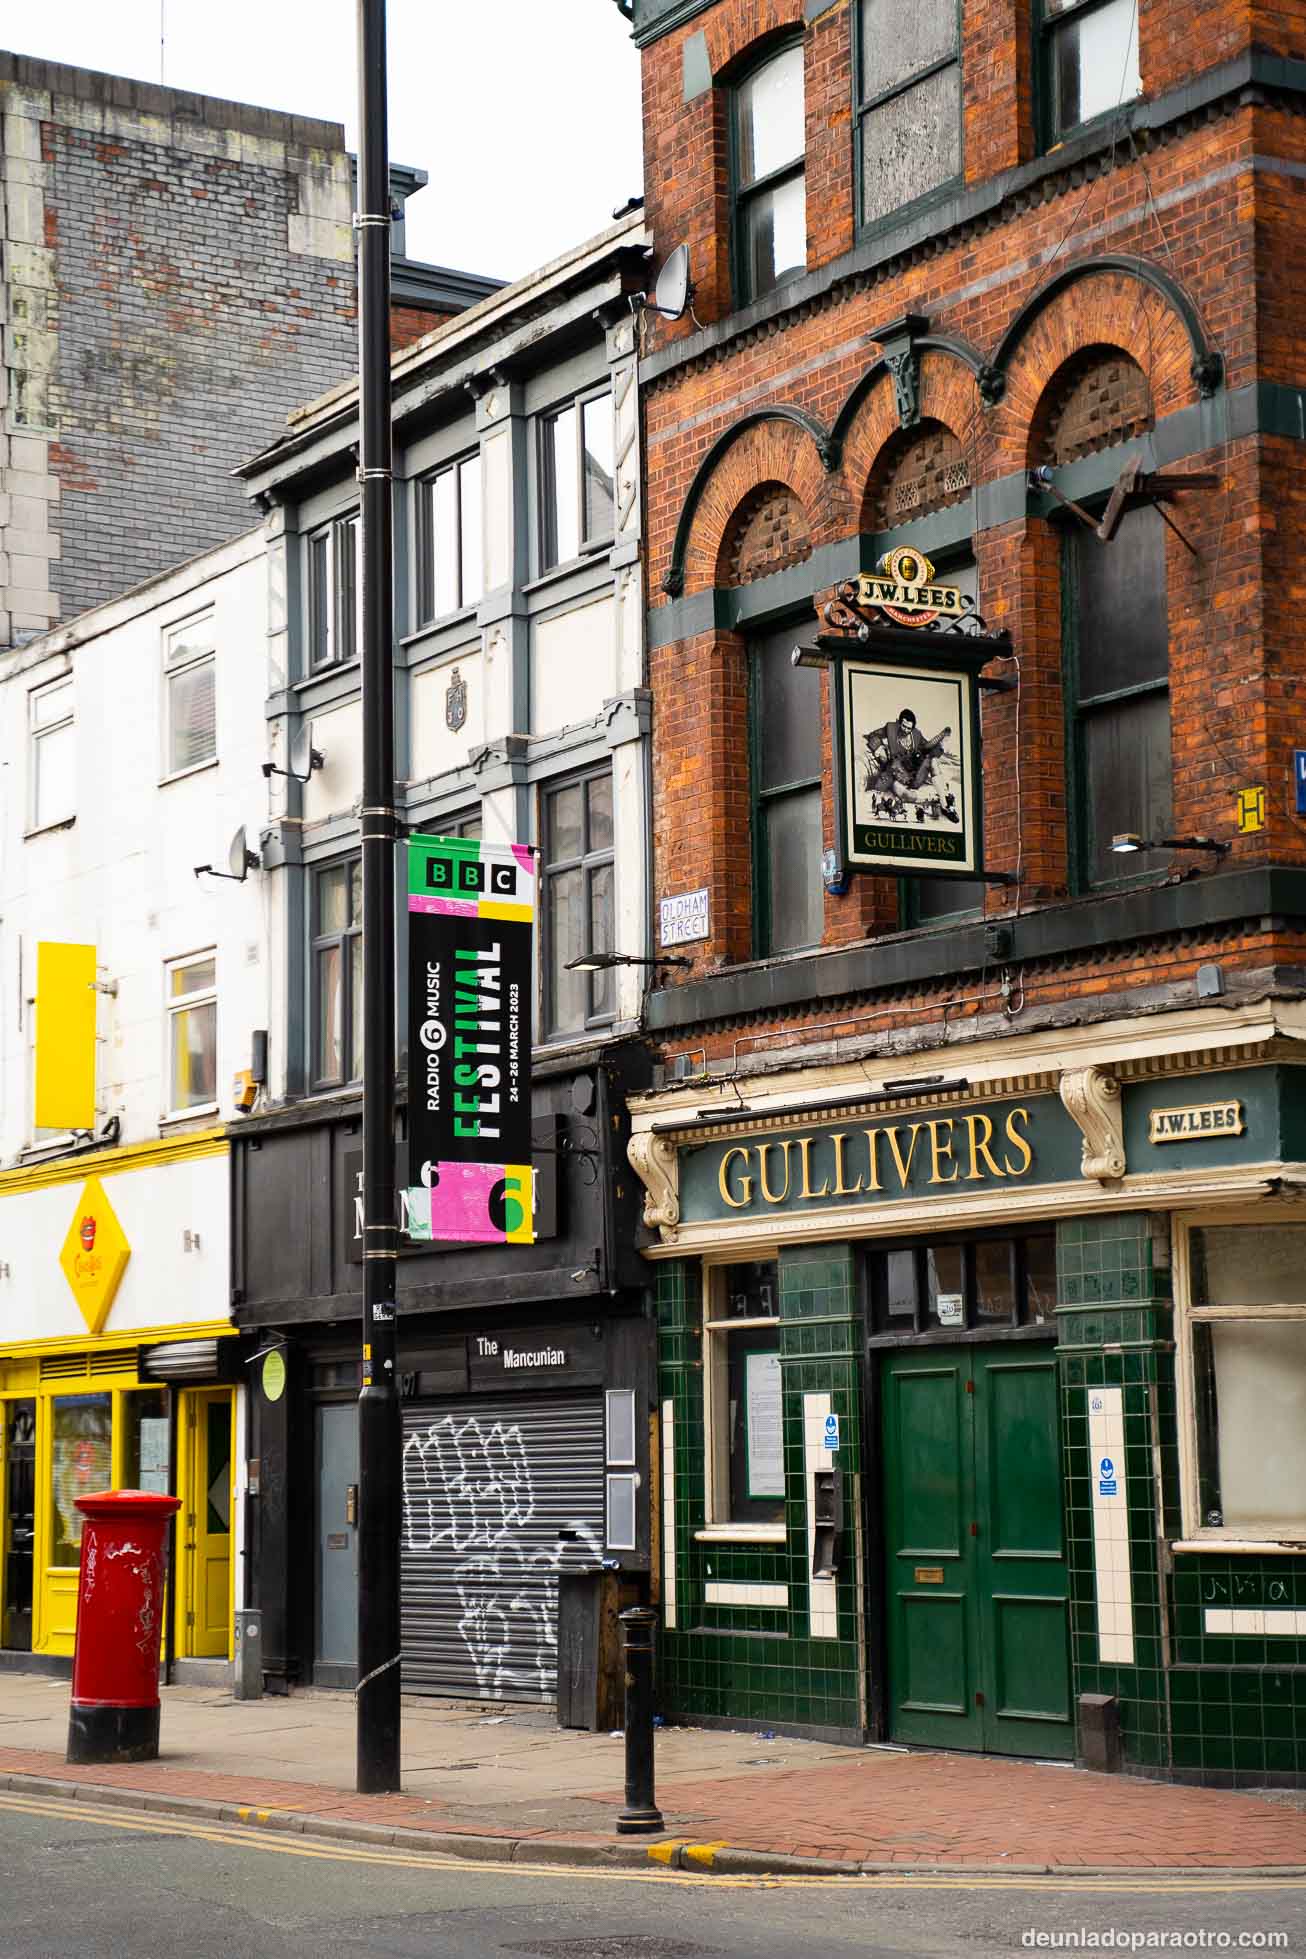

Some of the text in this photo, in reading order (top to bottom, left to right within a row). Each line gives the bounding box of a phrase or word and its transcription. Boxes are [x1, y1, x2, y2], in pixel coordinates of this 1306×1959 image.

[864, 582, 956, 608] J.W.LEES
[1240, 789, 1263, 830] H
[864, 831, 957, 854] GULLIVERS
[430, 860, 513, 892] BBC
[662, 895, 707, 921] OLDHAM
[663, 914, 706, 942] STREET
[427, 961, 440, 1017] MUSIC
[509, 983, 519, 1013] 2023
[454, 942, 501, 1138] FESTIVAL
[509, 1014, 519, 1060] MARCH
[427, 1054, 440, 1111] RADIO
[509, 1061, 519, 1077] 26
[509, 1087, 519, 1103] 24
[1156, 1108, 1236, 1133] J.W.LEES
[718, 1108, 1032, 1208] GULLIVERS
[488, 1178, 524, 1233] 6
[477, 1337, 565, 1368] The Mancunian
